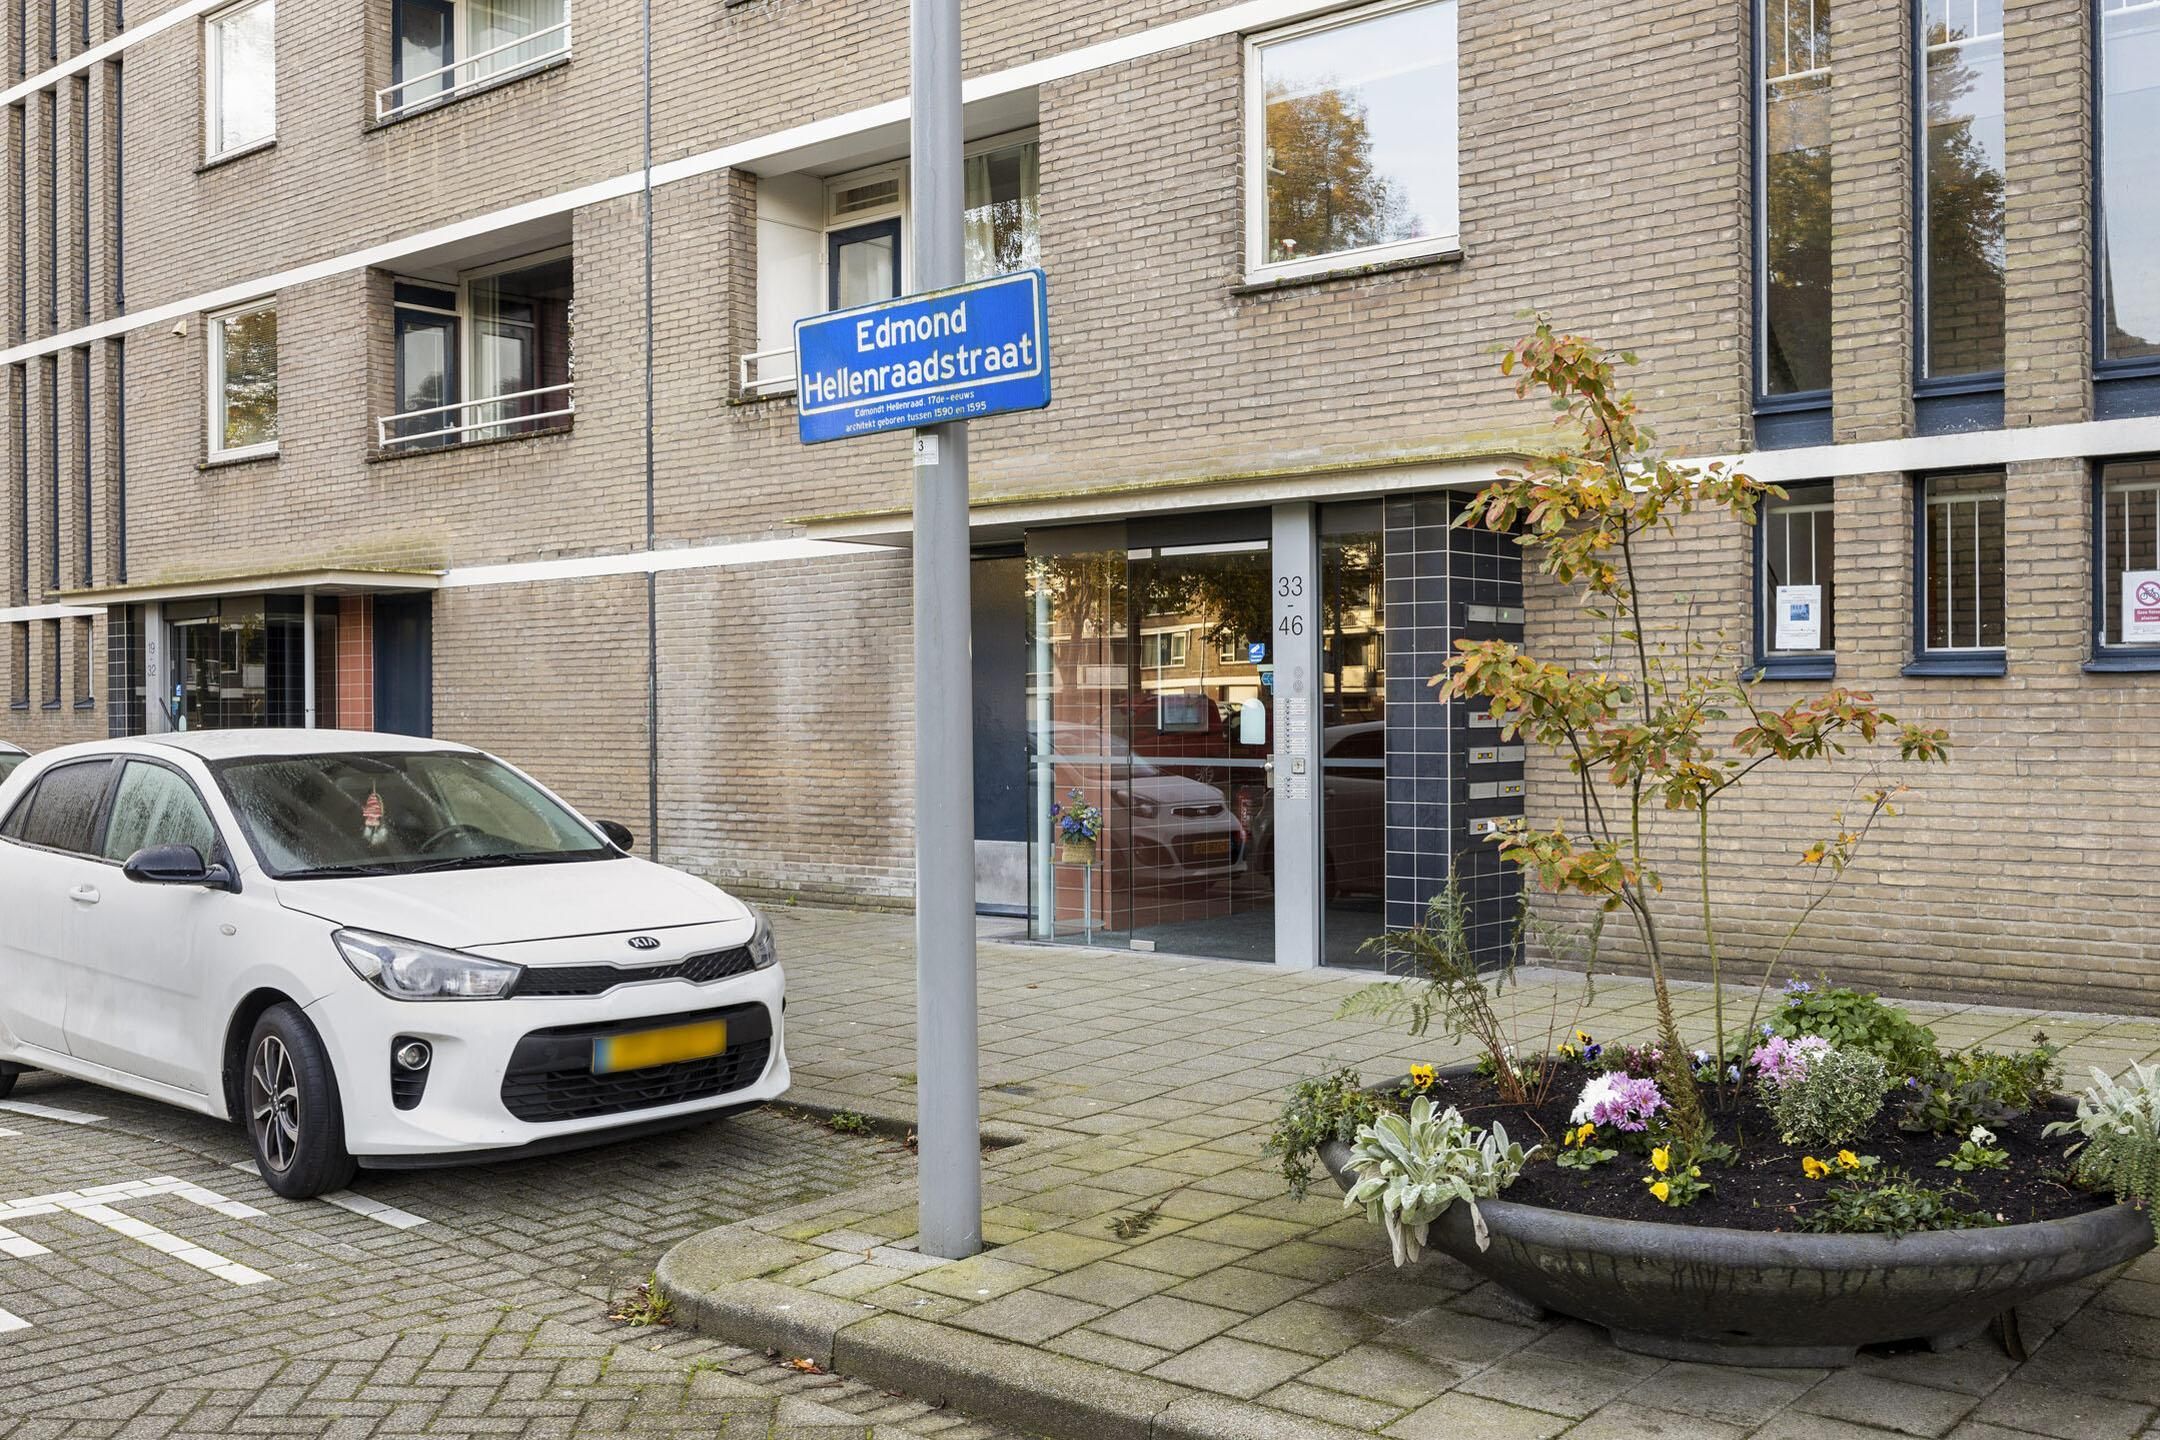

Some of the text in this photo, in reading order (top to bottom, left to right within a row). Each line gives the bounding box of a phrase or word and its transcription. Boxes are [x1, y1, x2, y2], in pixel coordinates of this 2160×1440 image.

[857, 301, 967, 352] Edmond
[804, 333, 1033, 404] Hellenraadstraat
[846, 401, 987, 432] architekt geboren tussen 1590 en 1595
[855, 407, 885, 418] Edmondt
[918, 440, 924, 452] 3
[1278, 575, 1303, 597] 33
[1278, 615, 1303, 636] 46
[630, 937, 658, 948] KIA
